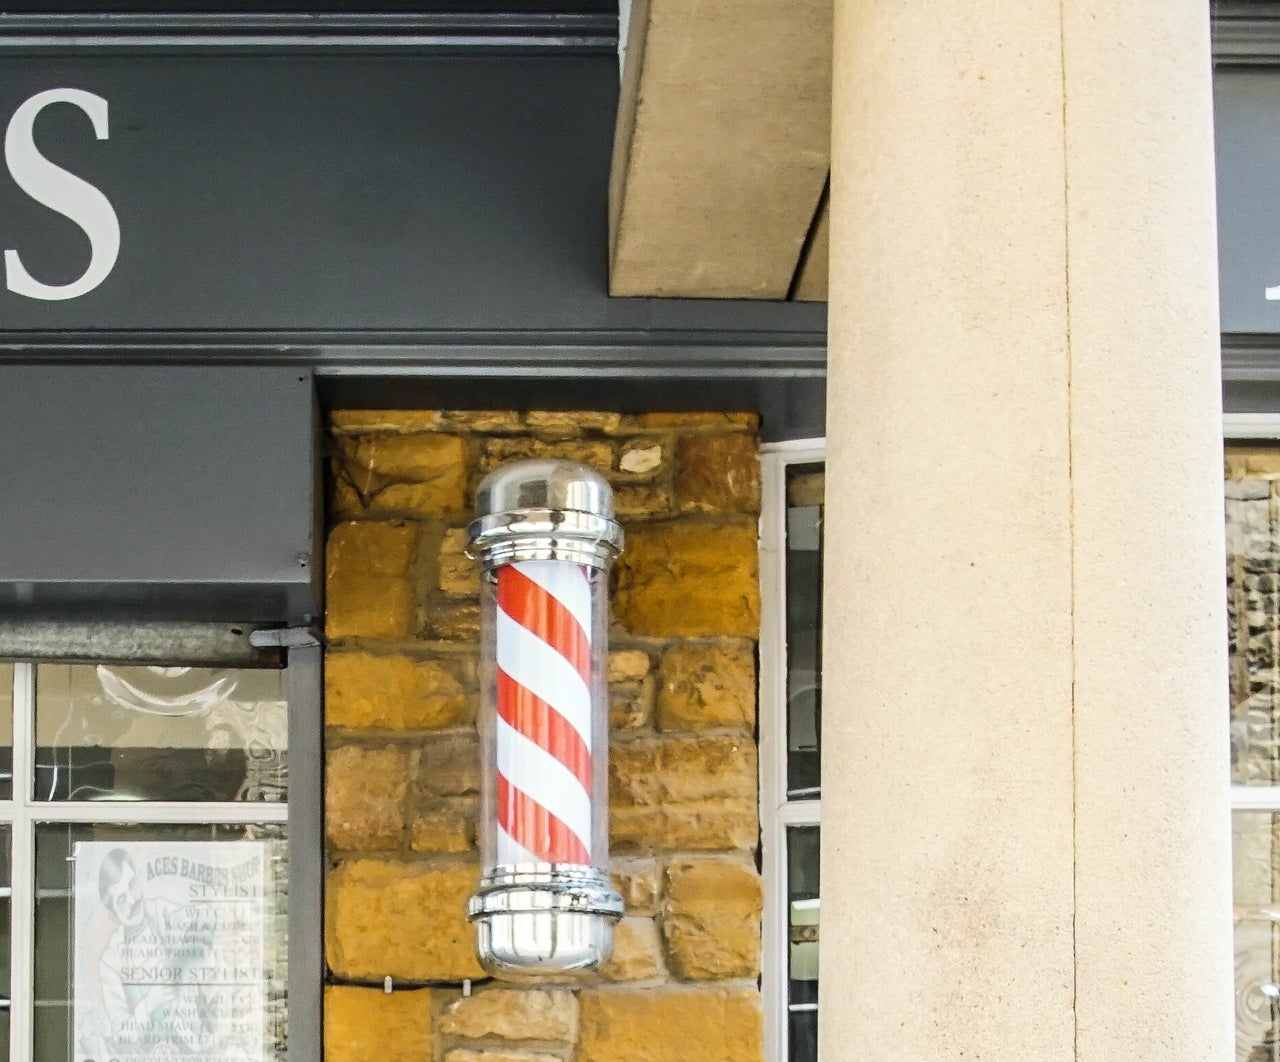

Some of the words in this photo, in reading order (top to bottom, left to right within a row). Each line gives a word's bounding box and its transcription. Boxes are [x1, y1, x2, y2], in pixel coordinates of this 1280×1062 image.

[146, 856, 179, 881] ACES
[189, 884, 257, 898] STYLIST
[120, 967, 183, 980] SENIOR
[189, 967, 258, 980] STYLIST
